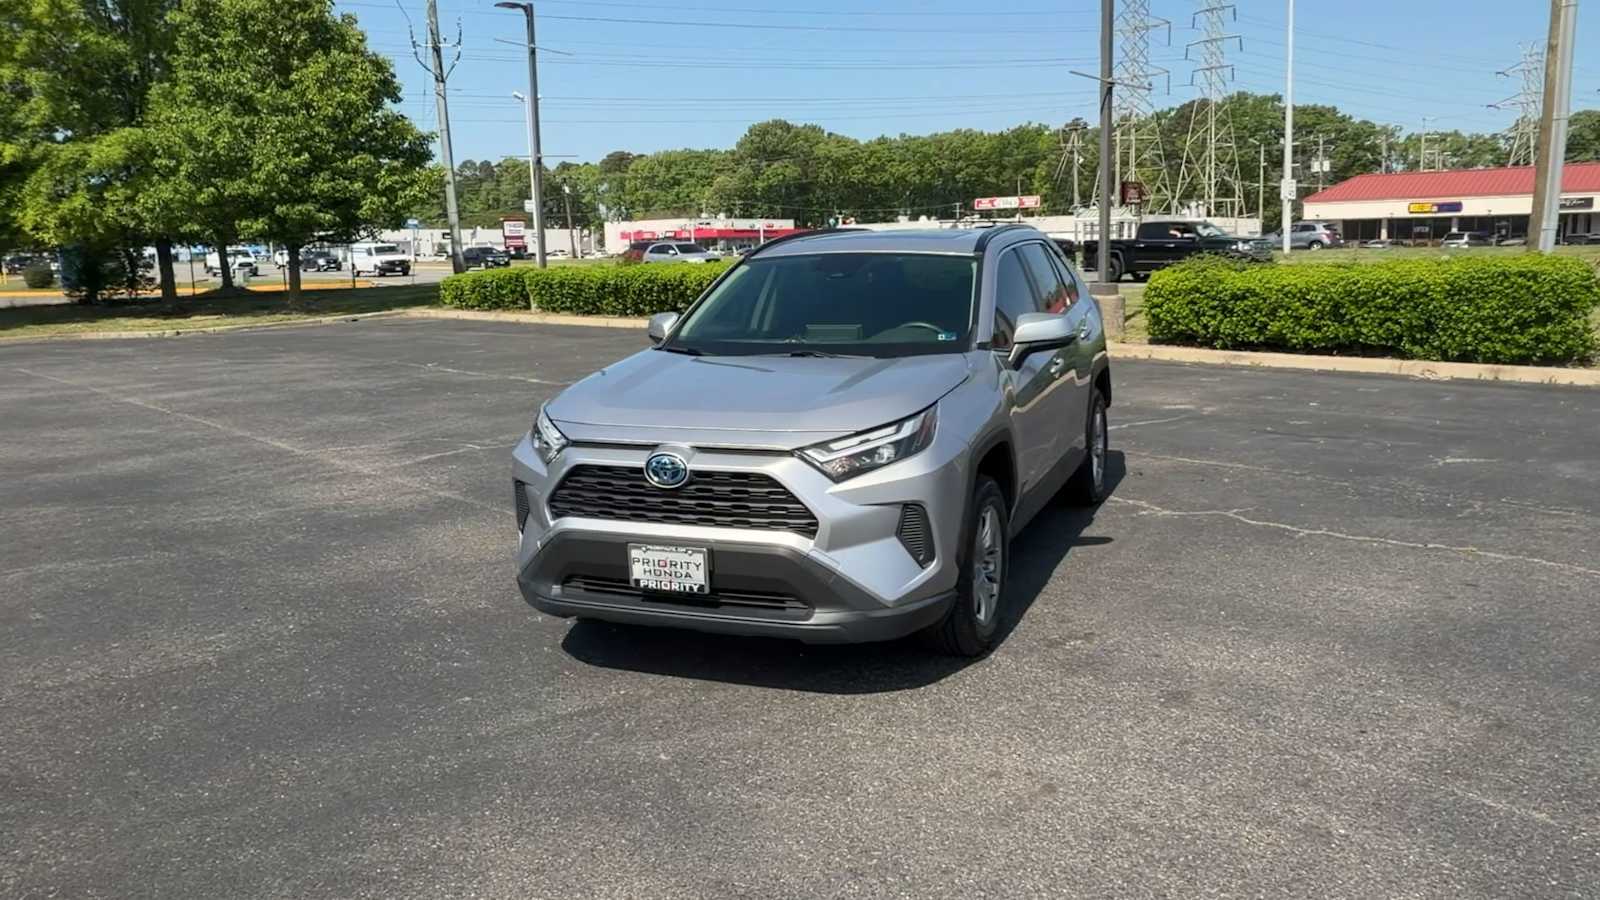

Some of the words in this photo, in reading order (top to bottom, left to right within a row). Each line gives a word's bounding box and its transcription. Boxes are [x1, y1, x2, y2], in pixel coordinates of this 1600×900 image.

[632, 557, 702, 571] PRIORITY
[643, 568, 693, 579] HONDA
[639, 579, 700, 592] PRIORITY
